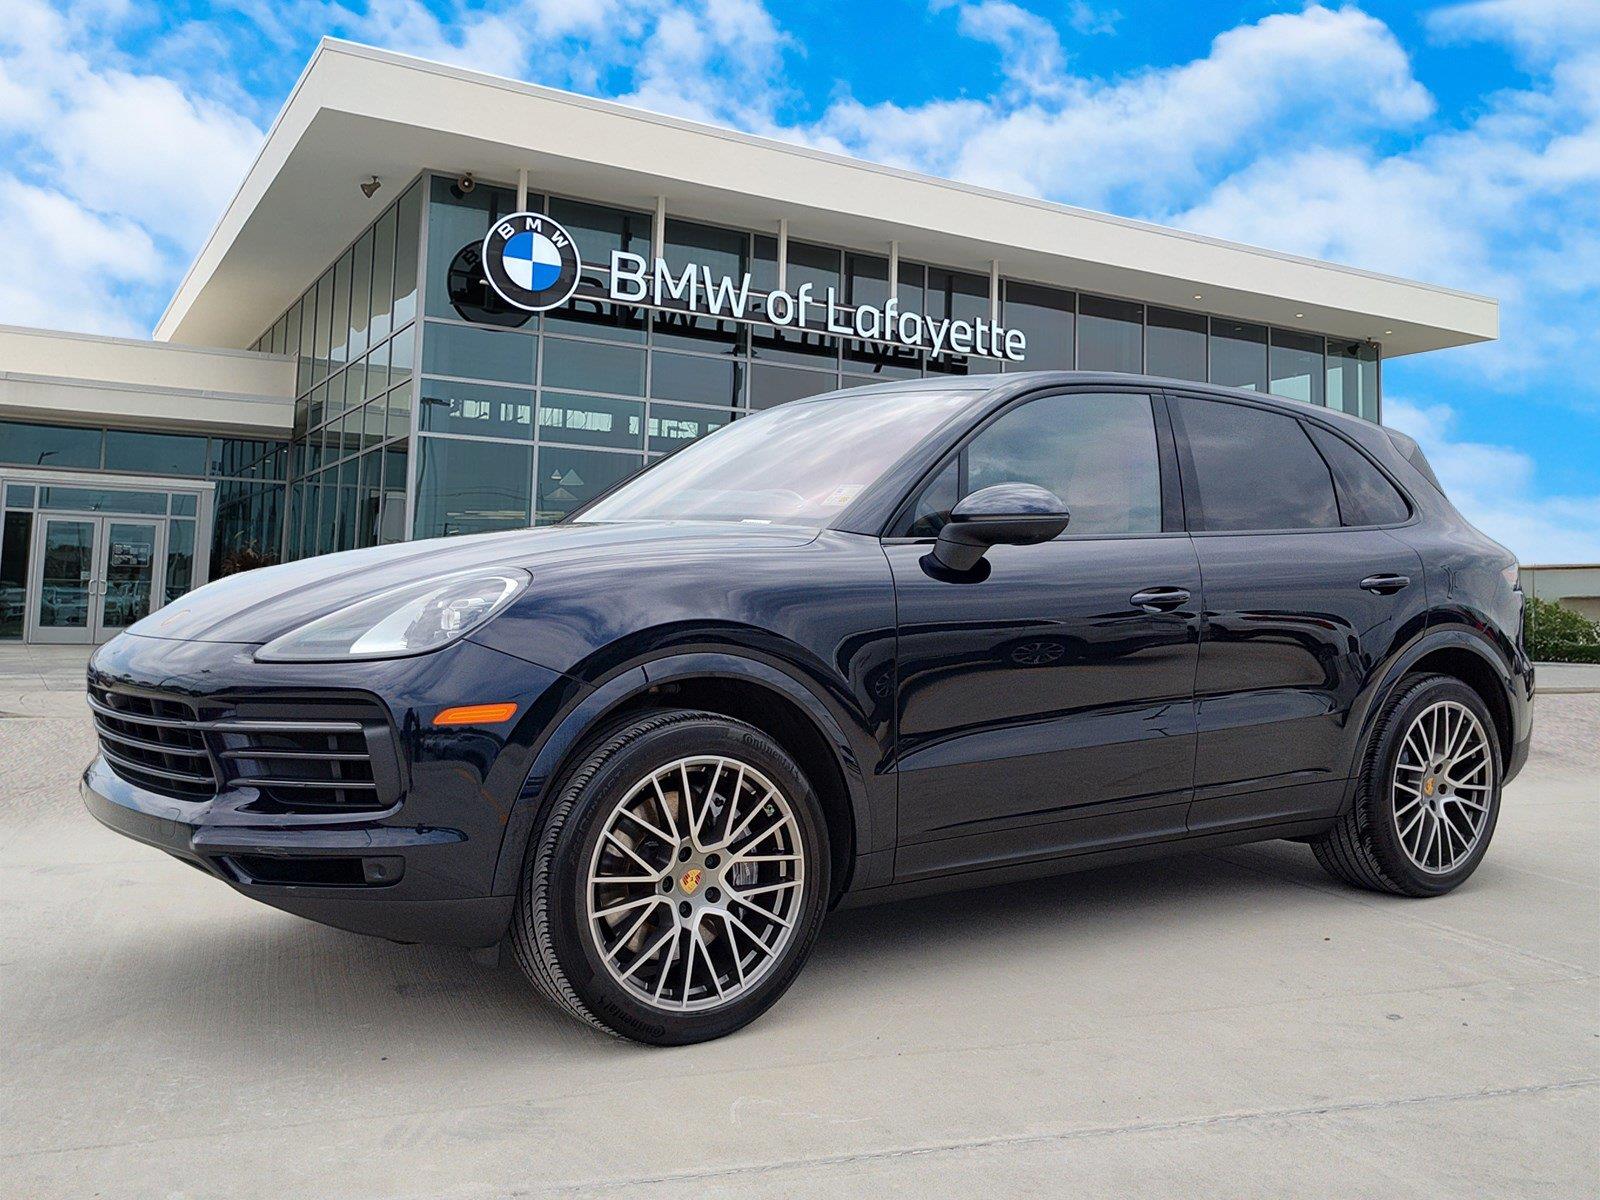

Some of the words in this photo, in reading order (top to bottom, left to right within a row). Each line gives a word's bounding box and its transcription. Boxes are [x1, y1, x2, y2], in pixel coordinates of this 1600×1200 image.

[497, 217, 569, 249] BMW
[610, 250, 751, 318] BMW
[766, 282, 813, 327] of
[827, 286, 1027, 361] Lafayette
